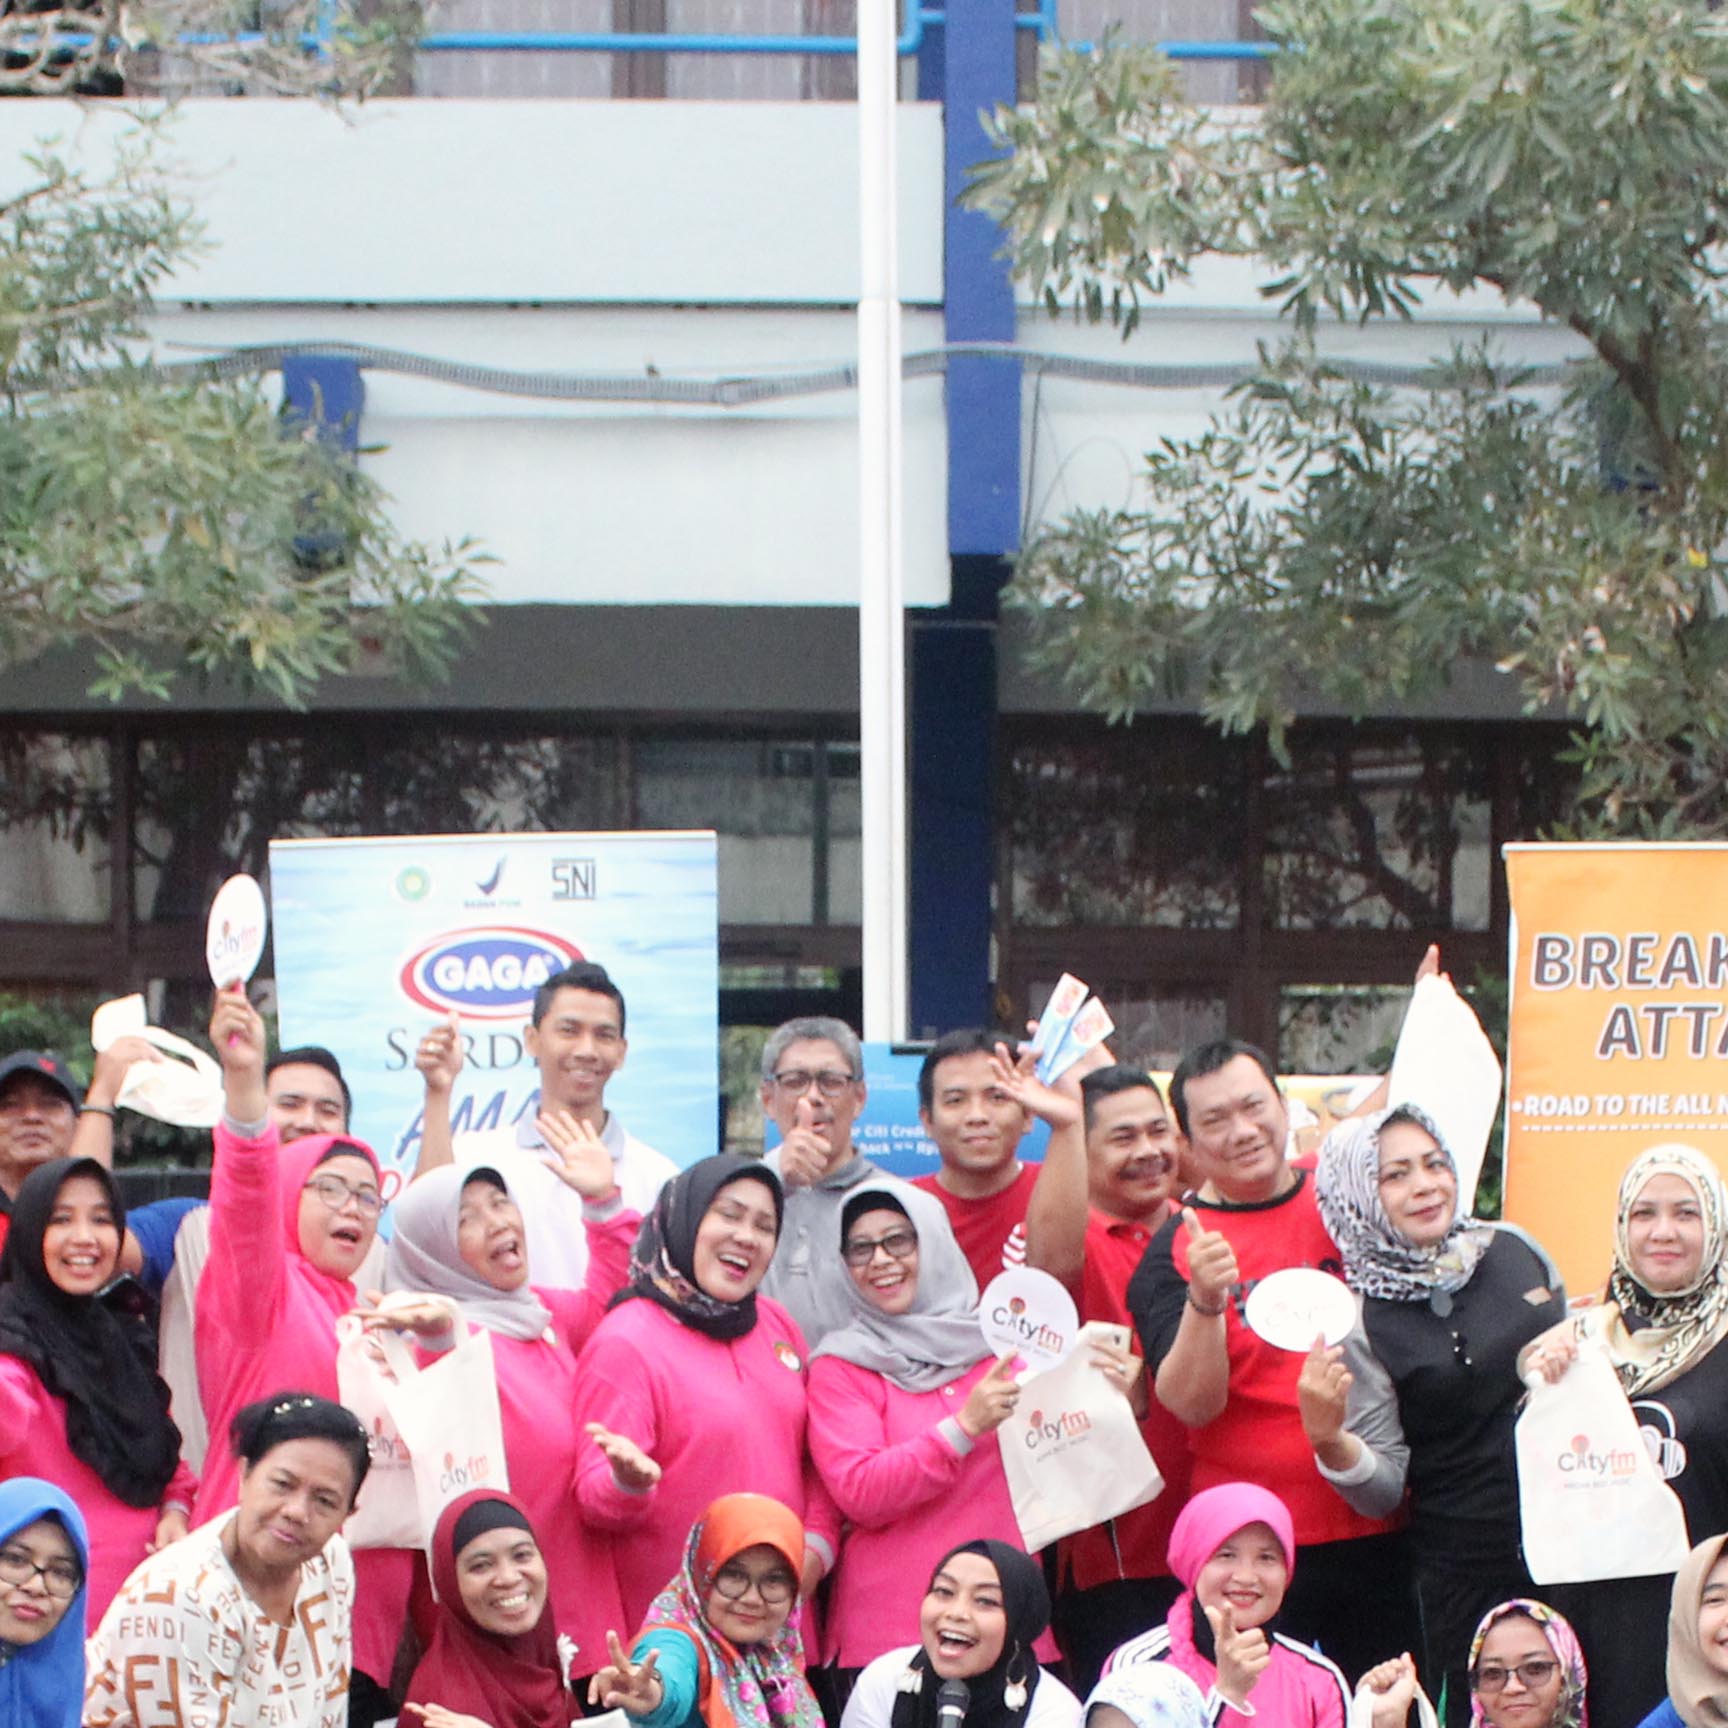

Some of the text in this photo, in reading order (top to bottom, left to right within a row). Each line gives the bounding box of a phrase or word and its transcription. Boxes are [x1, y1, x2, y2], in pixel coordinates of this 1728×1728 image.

[552, 858, 596, 900] SNI
[433, 954, 550, 993] GAGA
[1595, 1095, 1625, 1115] TO
[1629, 1094, 1670, 1115] THE
[1674, 1094, 1713, 1115] ALL
[992, 1297, 1064, 1350] Cityfm
[1025, 1410, 1091, 1449] Cityfm
[1558, 1434, 1636, 1475] Cityfm
[119, 1617, 185, 1641] FENDI
